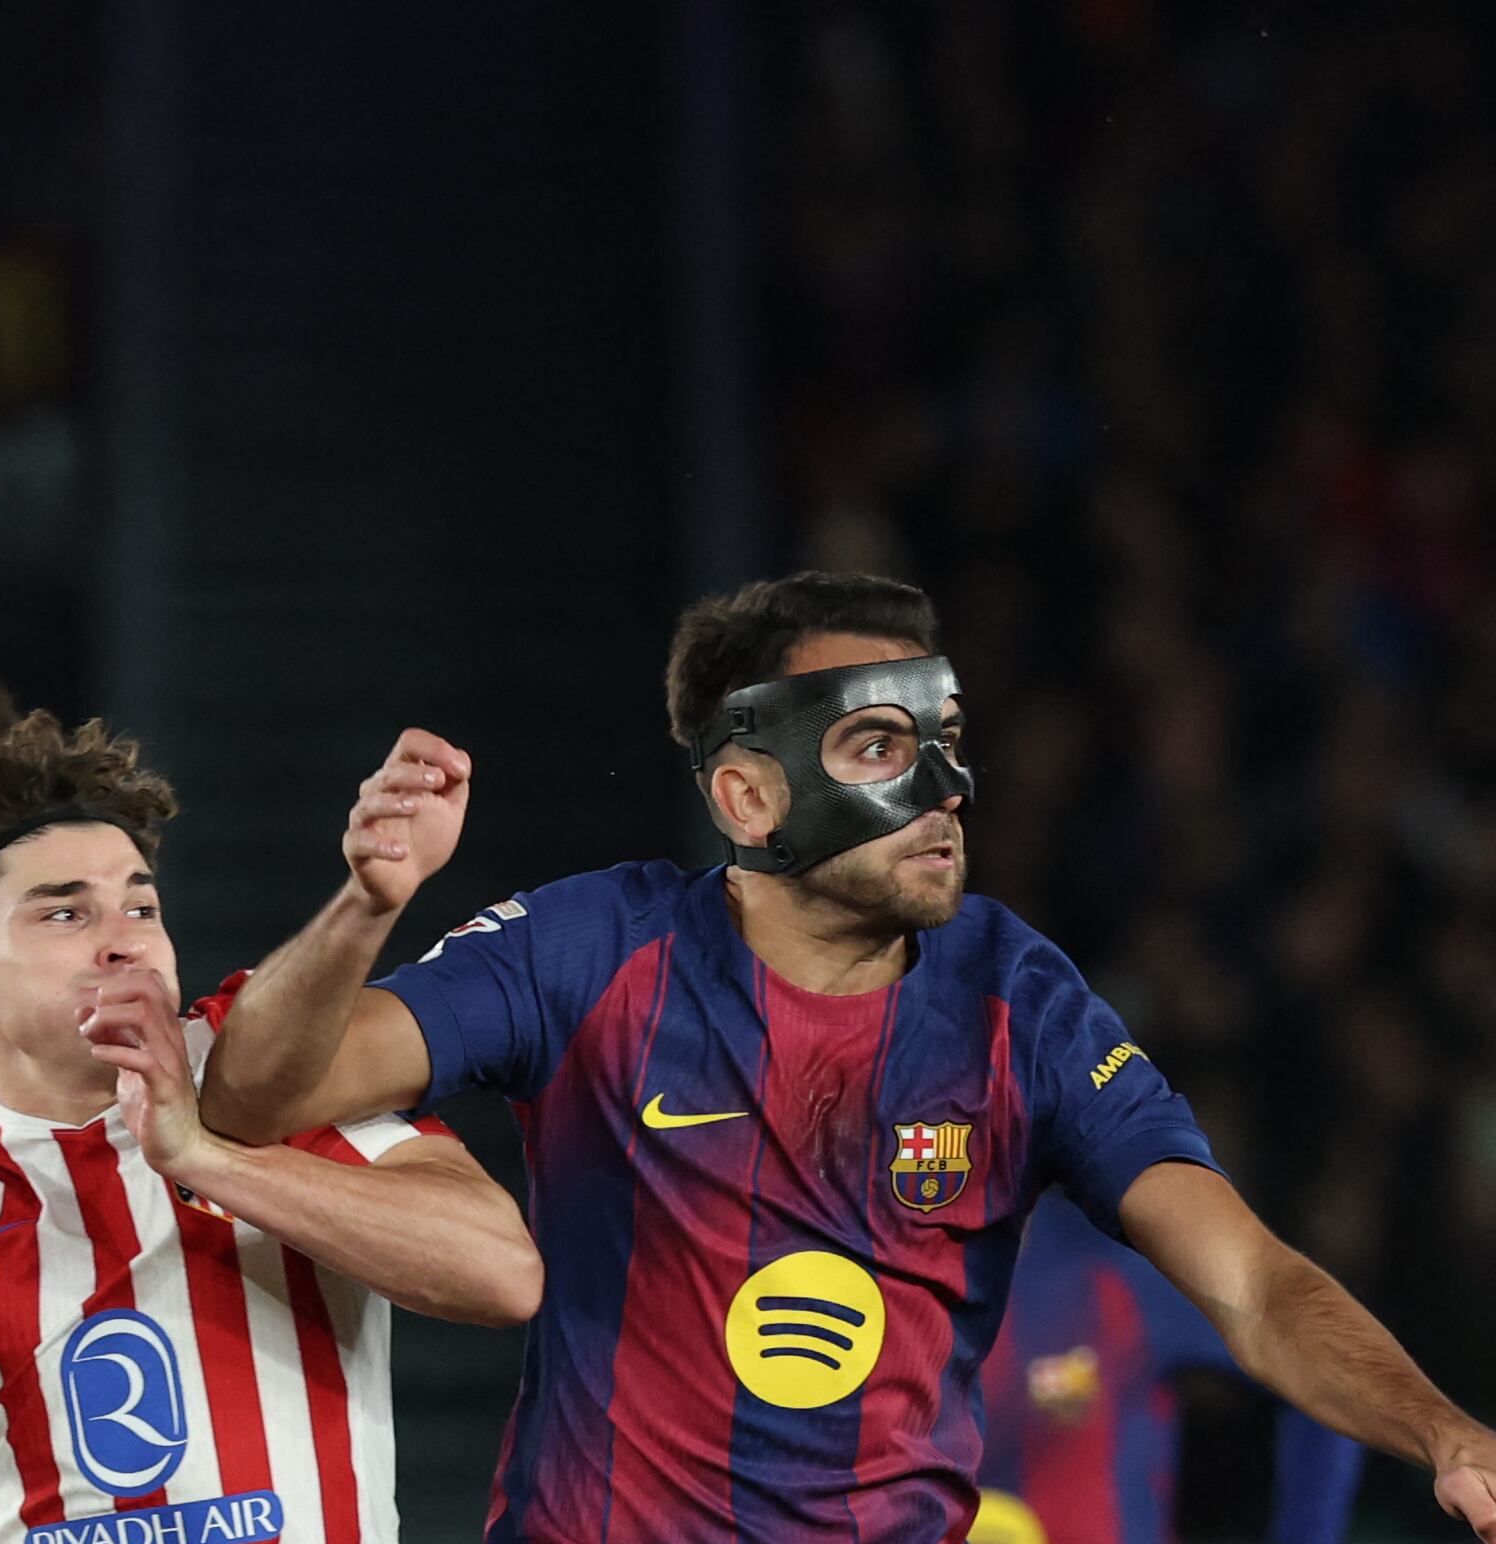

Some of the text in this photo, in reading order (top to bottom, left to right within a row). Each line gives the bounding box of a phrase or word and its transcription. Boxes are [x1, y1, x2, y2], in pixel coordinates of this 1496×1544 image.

[1089, 1042, 1151, 1090] AMBI
[917, 1160, 947, 1171] FCB
[200, 1497, 278, 1544] AIR
